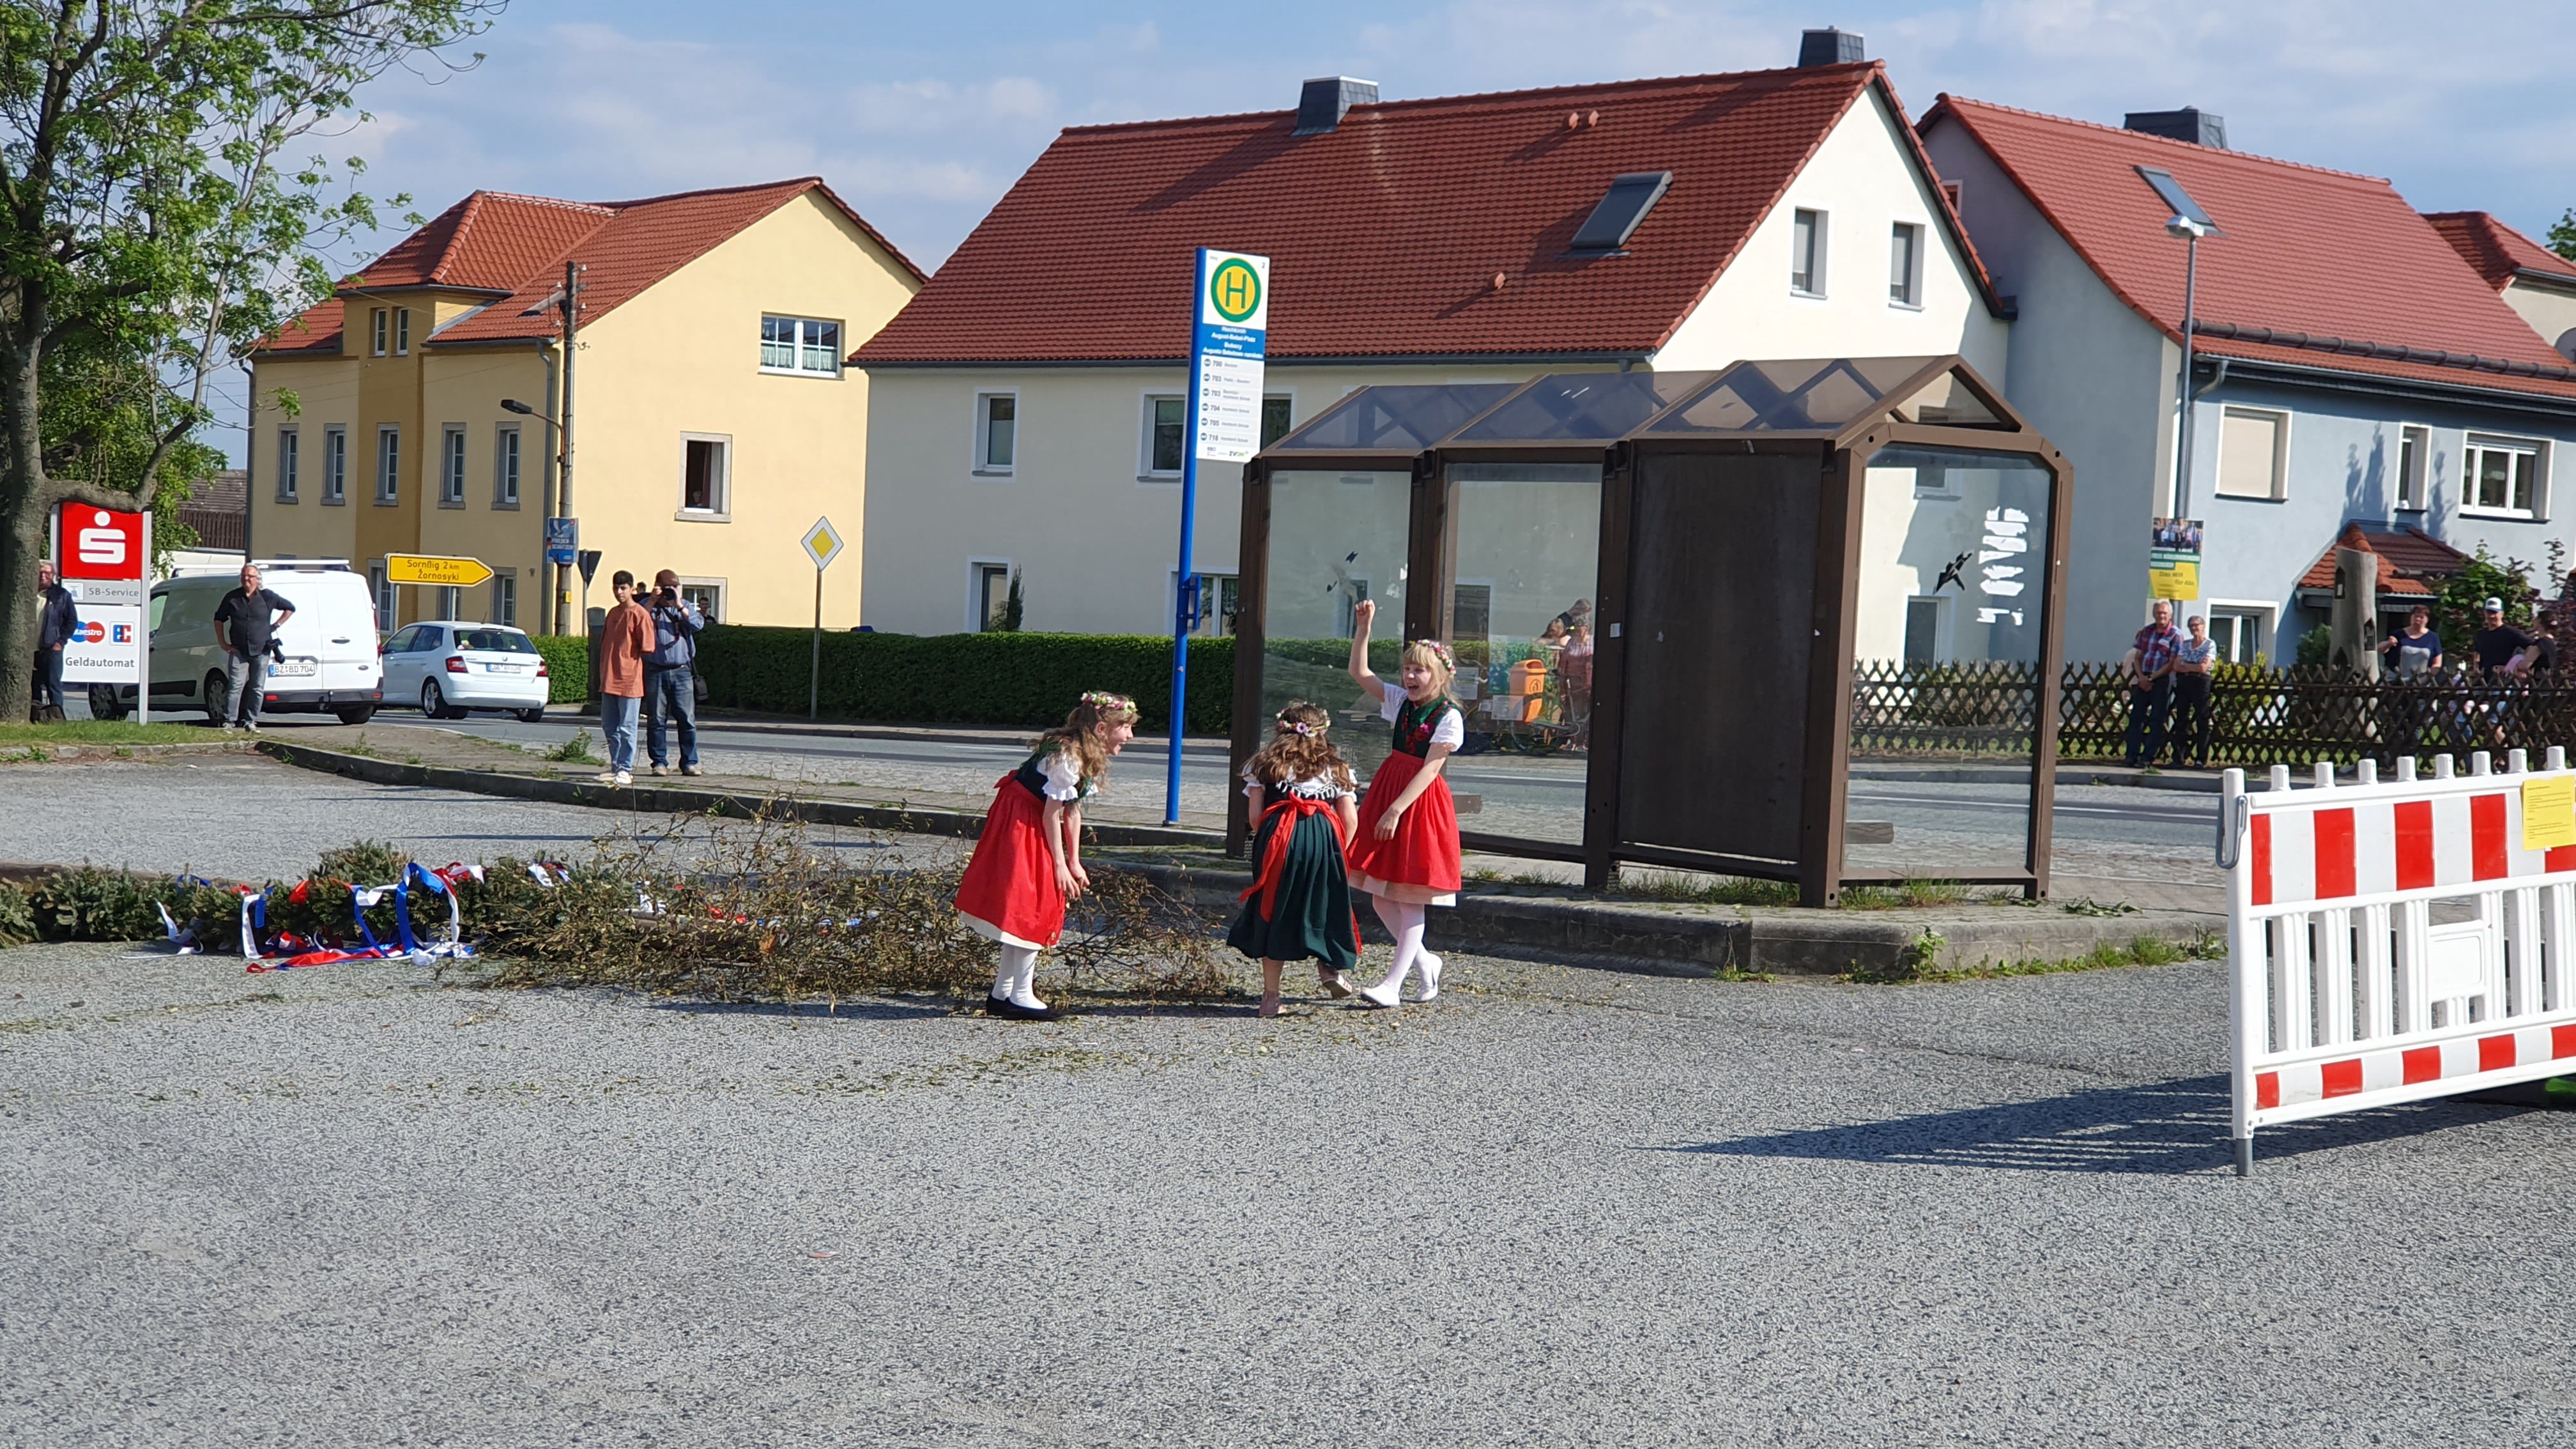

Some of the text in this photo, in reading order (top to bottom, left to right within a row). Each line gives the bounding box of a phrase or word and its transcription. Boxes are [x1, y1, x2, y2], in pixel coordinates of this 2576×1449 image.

[1225, 272, 1247, 309] H
[407, 559, 440, 571] Sornßig
[443, 561, 448, 570] 2
[418, 569, 459, 582] Žornosyki
[89, 587, 139, 597] SB-Service
[65, 657, 135, 668] Geldautomat
